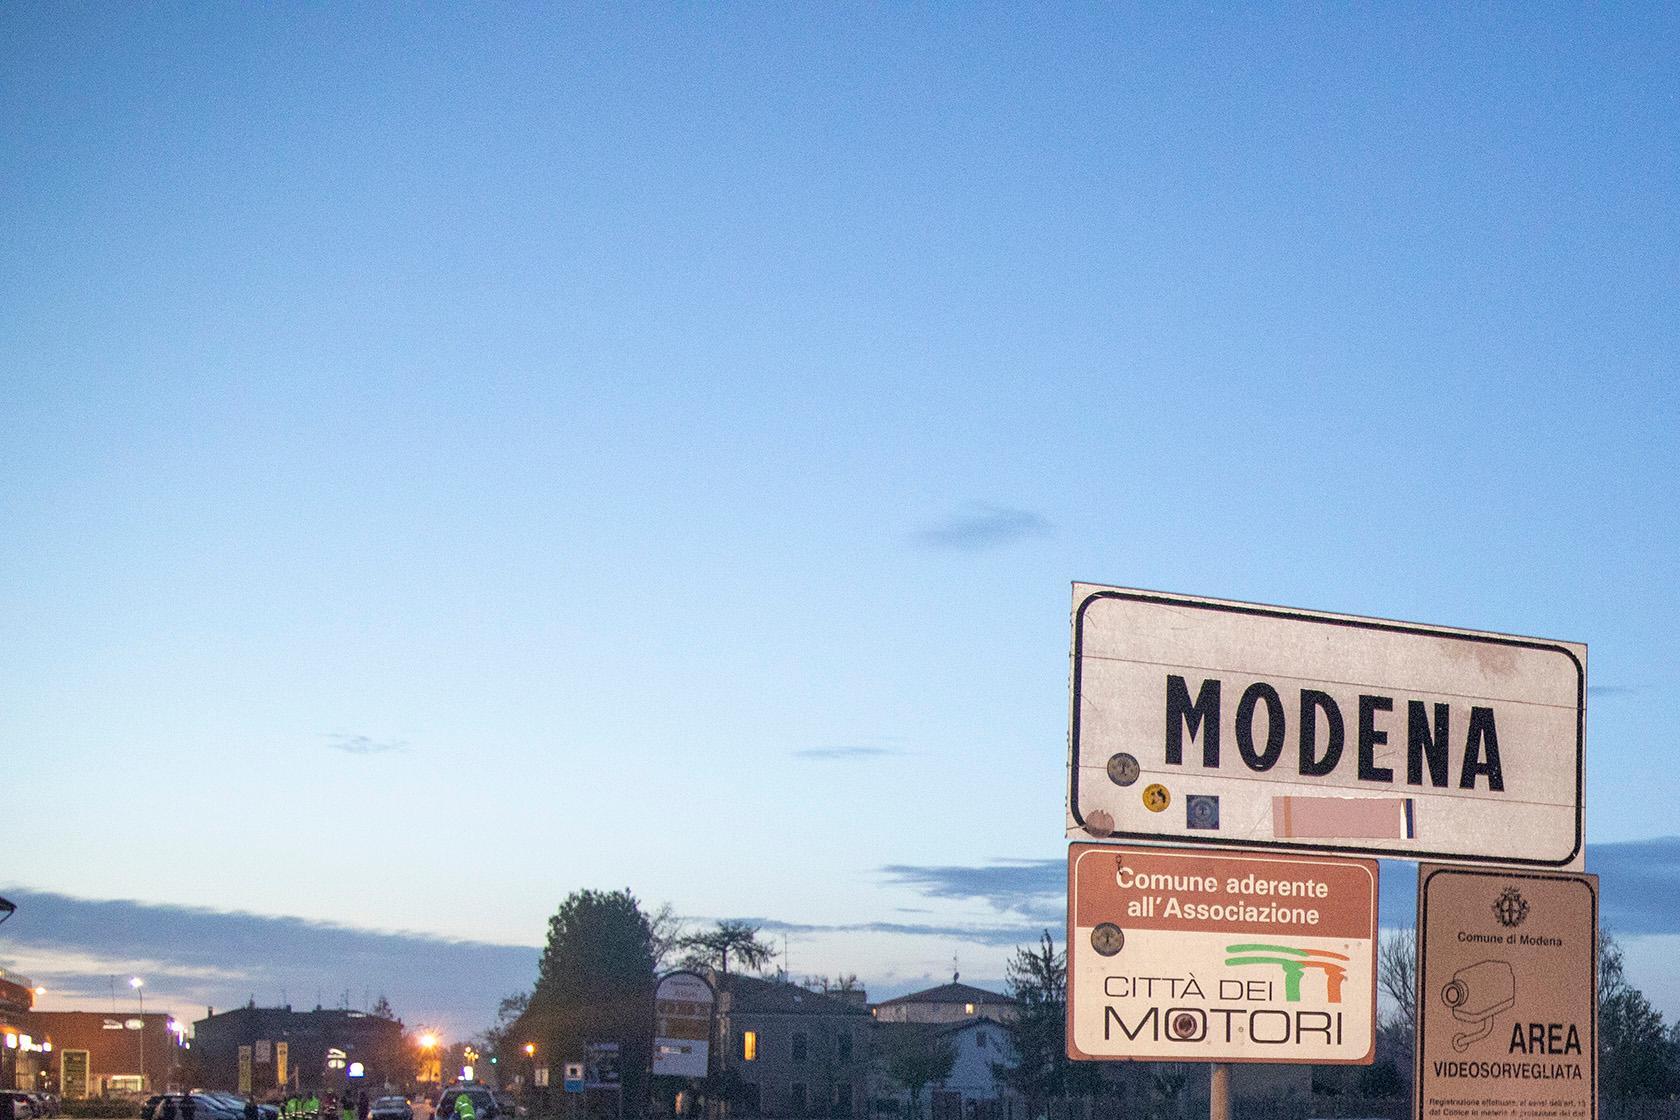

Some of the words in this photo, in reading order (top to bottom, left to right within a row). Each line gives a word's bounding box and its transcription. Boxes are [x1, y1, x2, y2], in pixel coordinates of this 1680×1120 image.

[1165, 674, 1506, 792] MODENA
[1116, 867, 1218, 893] Comune
[1226, 874, 1328, 898] aderente
[1127, 897, 1320, 924] all'Associazione
[1457, 931, 1504, 944] Comune
[1506, 934, 1516, 945] di
[1520, 935, 1563, 947] Modena
[1104, 972, 1206, 1000] CITTÀ
[1219, 979, 1273, 1001] DEI
[1104, 1005, 1343, 1045] MOTORI
[1508, 1022, 1582, 1055] AREA
[1433, 1060, 1583, 1080] VIDEOSORVEGLIATA
